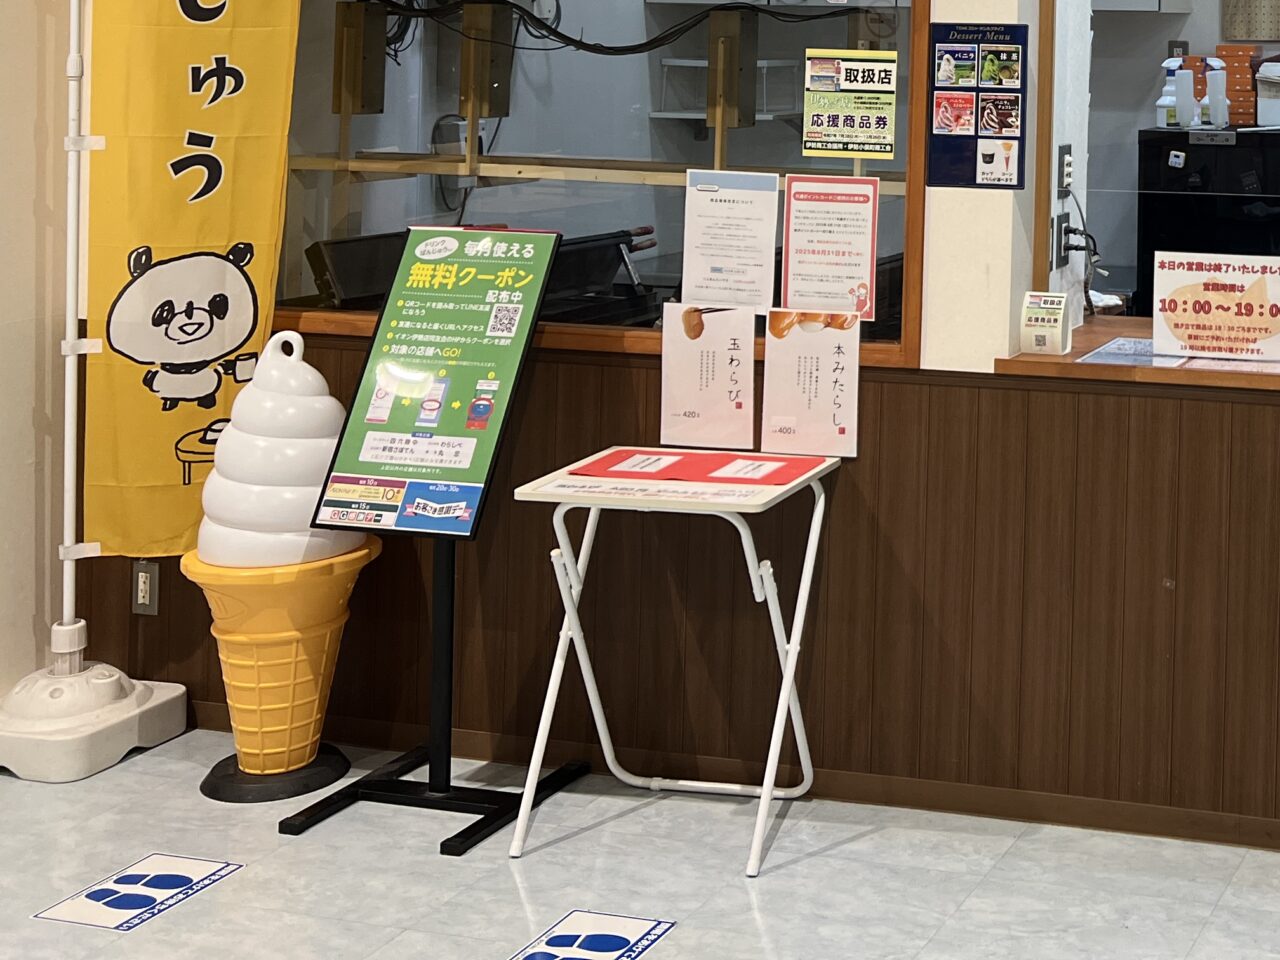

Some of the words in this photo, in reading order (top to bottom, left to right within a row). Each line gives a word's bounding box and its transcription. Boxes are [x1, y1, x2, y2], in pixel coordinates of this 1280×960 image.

[949, 31, 982, 40] Dessert
[984, 31, 1010, 40] Menu
[844, 68, 892, 85] 取扱店
[811, 113, 888, 129] 応援商品券
[464, 240, 535, 258] 毎月使える
[405, 262, 534, 290] 無料クーポン
[485, 290, 523, 303] 配布中
[728, 337, 741, 402] 玉わらび
[832, 343, 845, 427] 本みたらし
